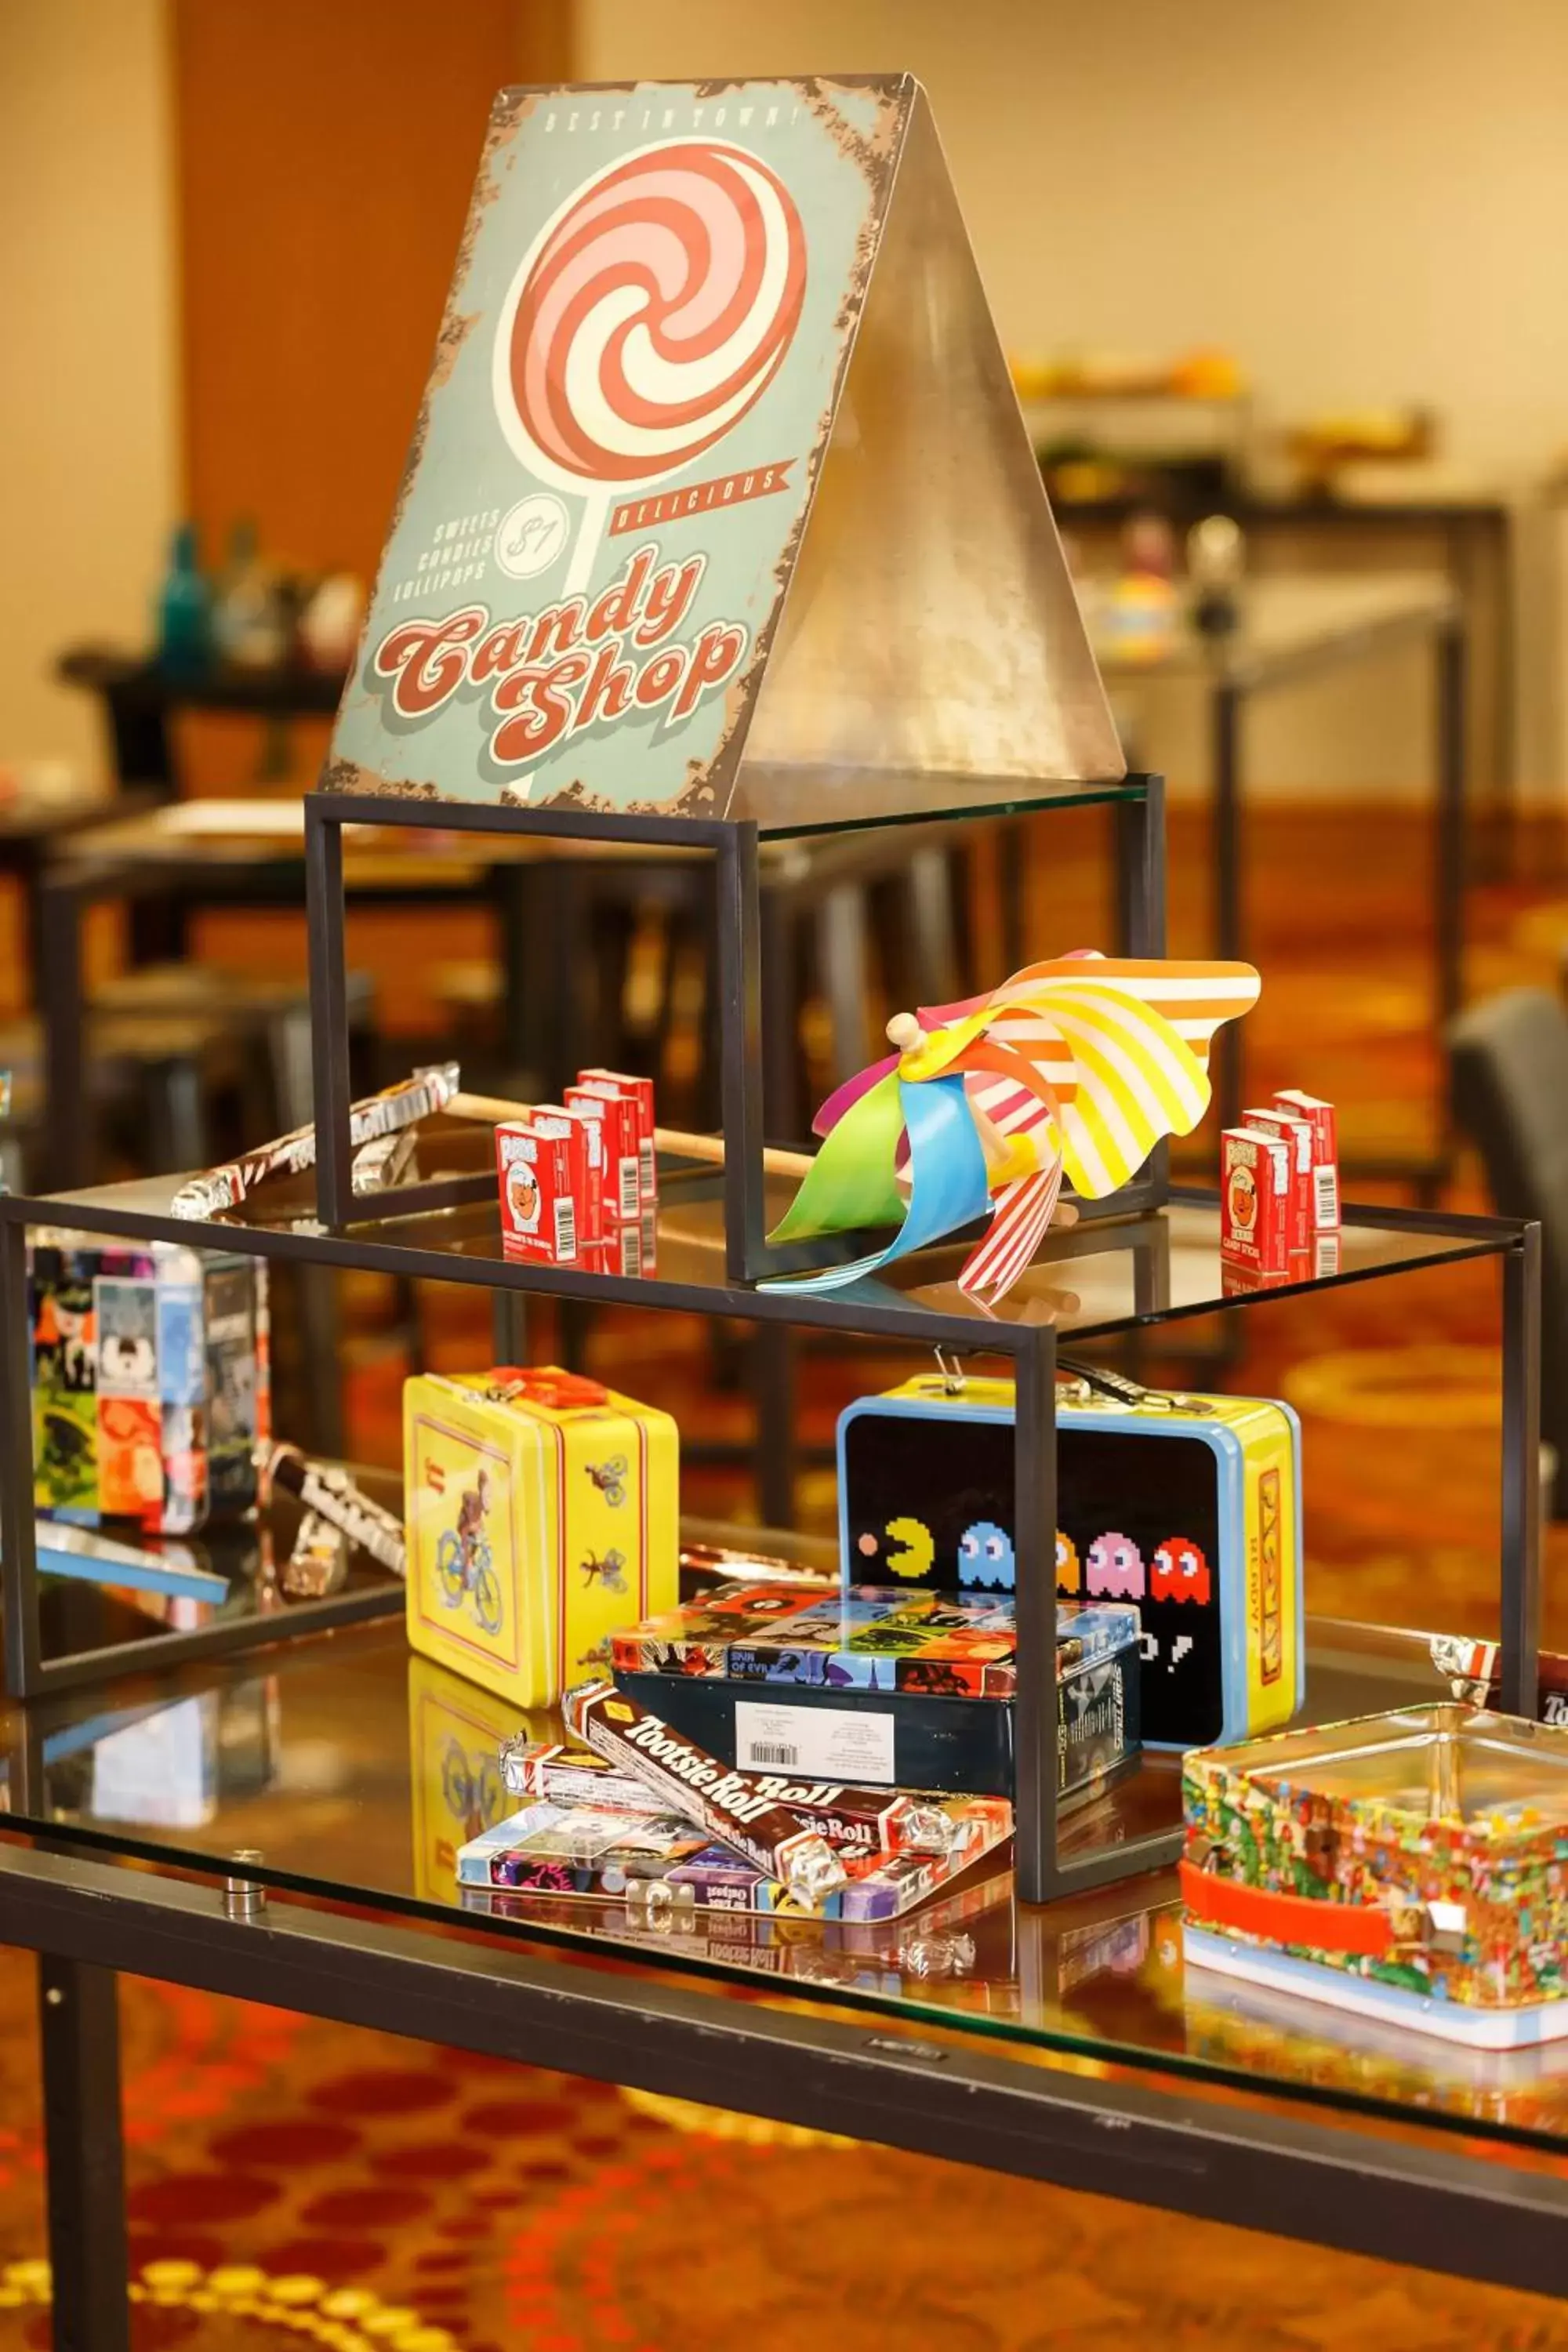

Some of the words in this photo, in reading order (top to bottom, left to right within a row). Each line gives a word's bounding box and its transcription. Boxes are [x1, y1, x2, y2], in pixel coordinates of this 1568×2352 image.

[545, 111, 625, 132] BEST
[641, 109, 675, 129] IN
[693, 107, 799, 129] TOWN!
[618, 470, 776, 529] DELICIOUS
[433, 508, 500, 544] SWEETS
[417, 535, 494, 573] CANDIES
[394, 560, 486, 604] LOLLIPOPS
[376, 543, 707, 717] Candy
[491, 622, 746, 764] Shop
[624, 1715, 718, 1788] Tootsie
[701, 1771, 779, 1824] Roll
[754, 1776, 844, 1806] Roll
[827, 1818, 872, 1844] Roll
